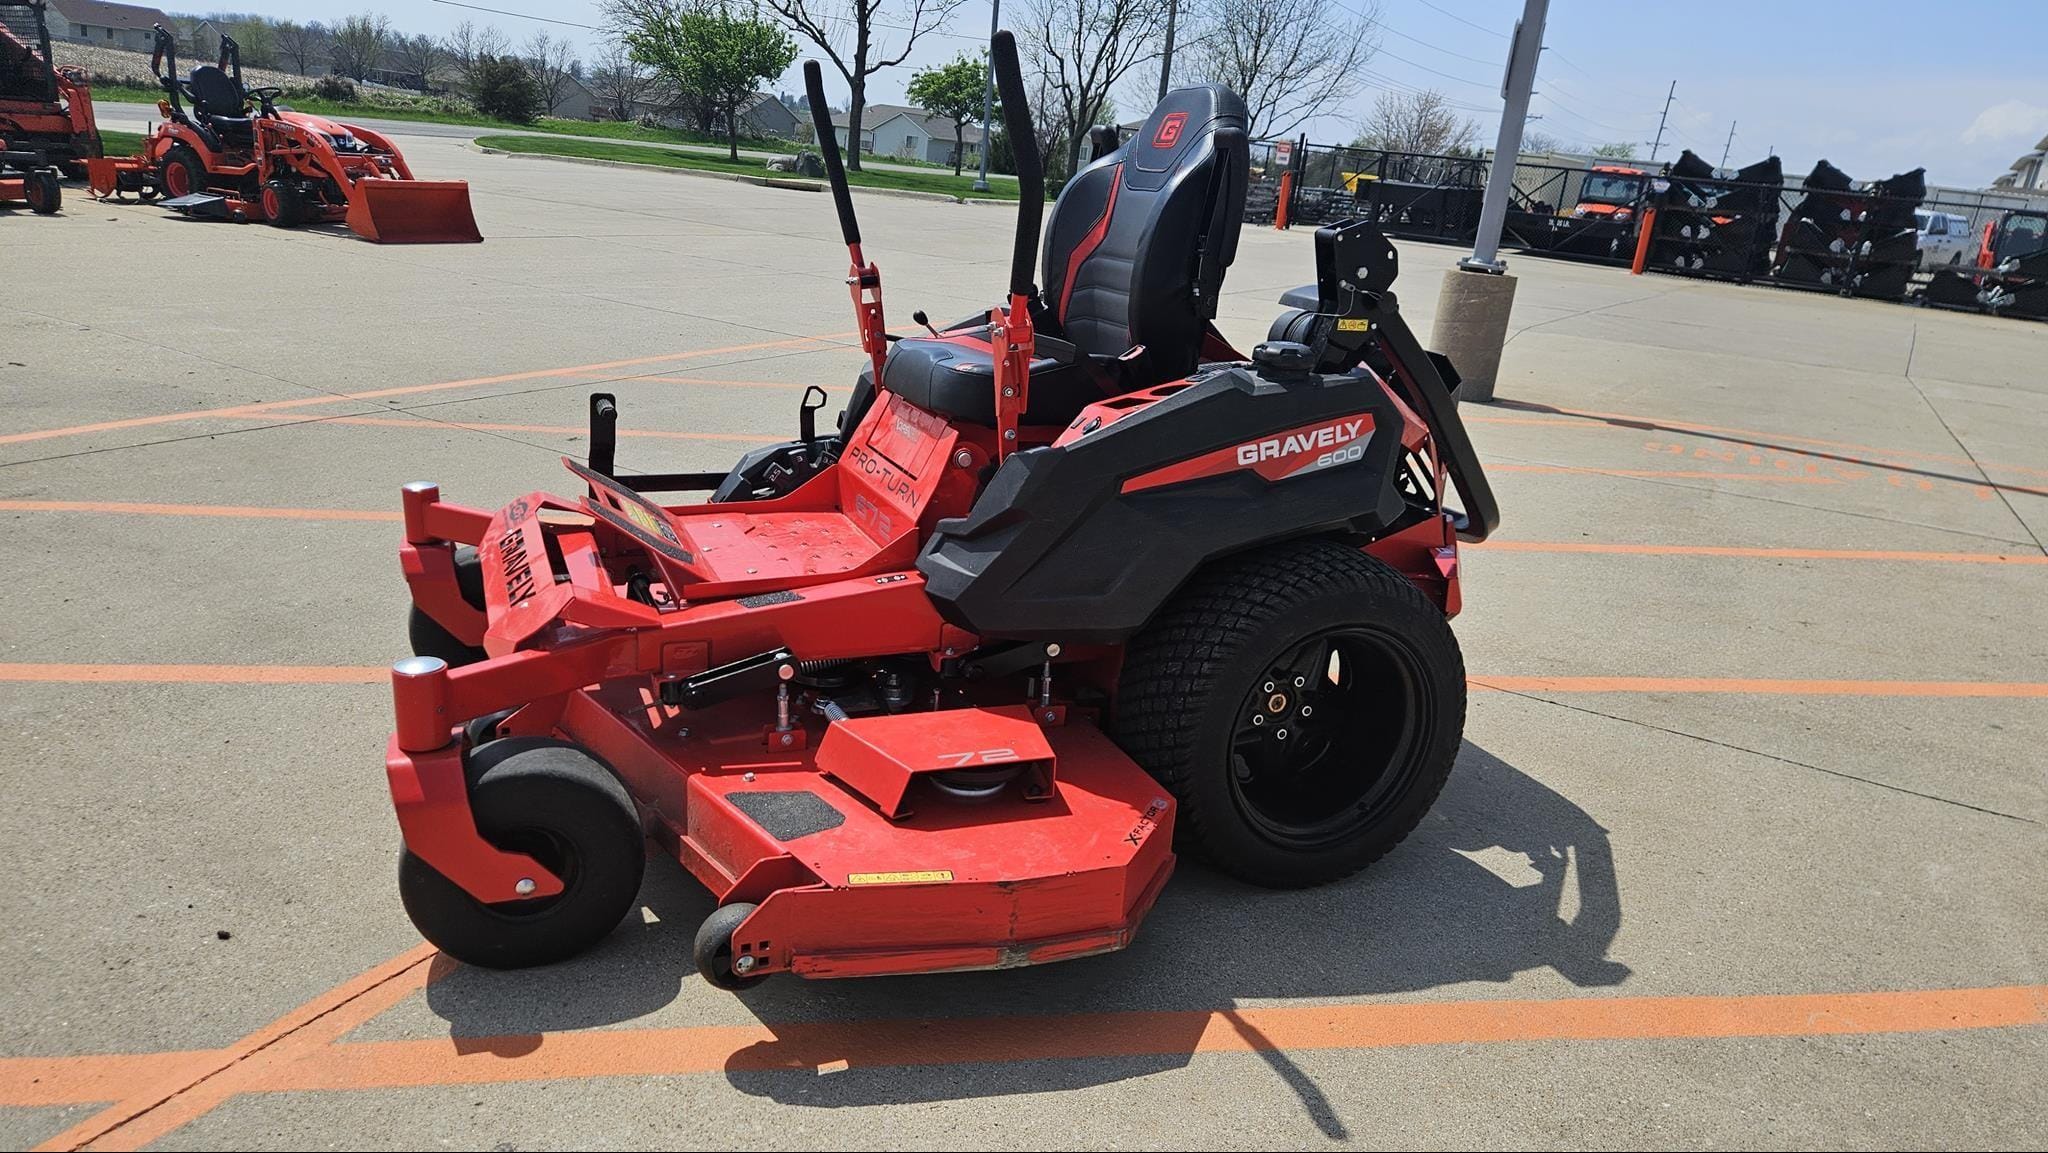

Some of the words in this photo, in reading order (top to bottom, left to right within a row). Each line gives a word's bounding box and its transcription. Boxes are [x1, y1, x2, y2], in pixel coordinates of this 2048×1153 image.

[1237, 419, 1364, 466] GRAVELY
[1317, 445, 1362, 467] 600
[849, 446, 921, 508] PRO-TURN
[499, 528, 536, 608] GRAVELY
[937, 748, 1019, 767] 72
